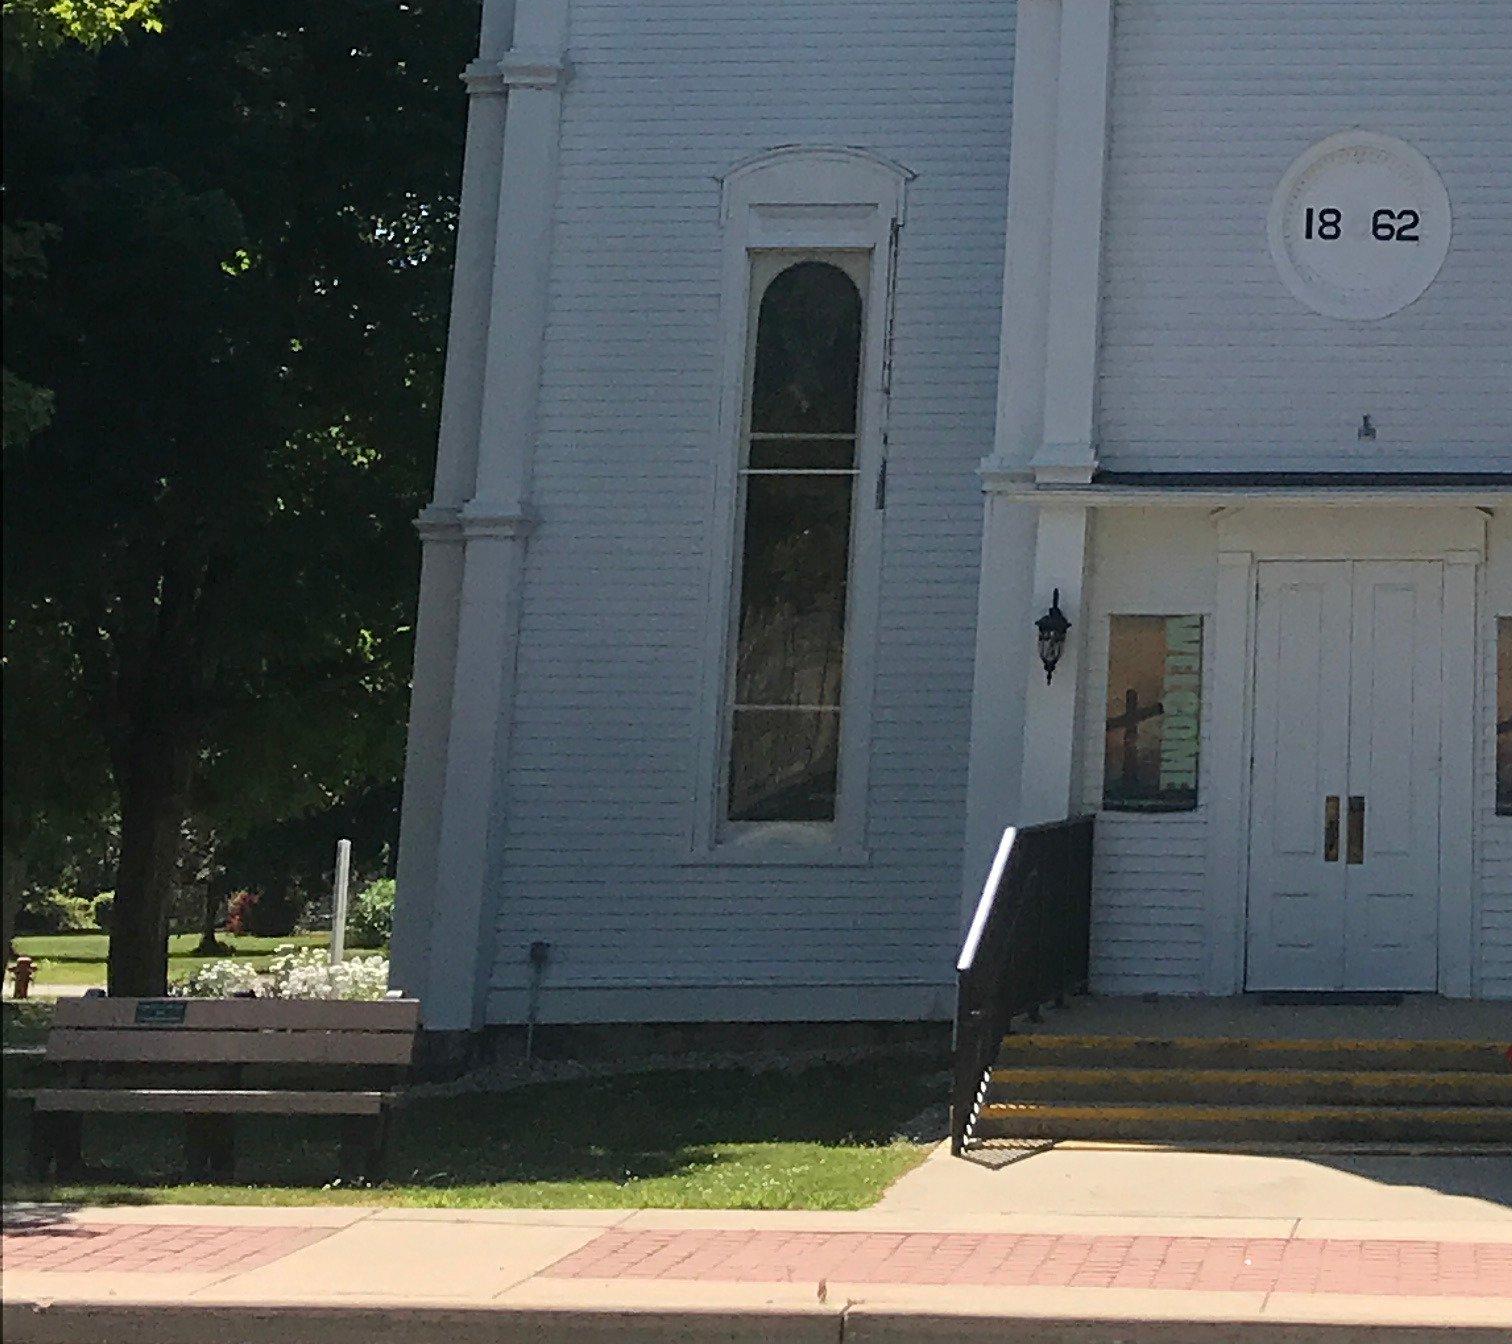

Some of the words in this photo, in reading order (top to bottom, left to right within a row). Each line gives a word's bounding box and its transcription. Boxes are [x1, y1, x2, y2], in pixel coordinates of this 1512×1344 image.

[1304, 208, 1342, 240] 18
[1371, 209, 1420, 241] 62
[1159, 616, 1201, 791] WELCOME
